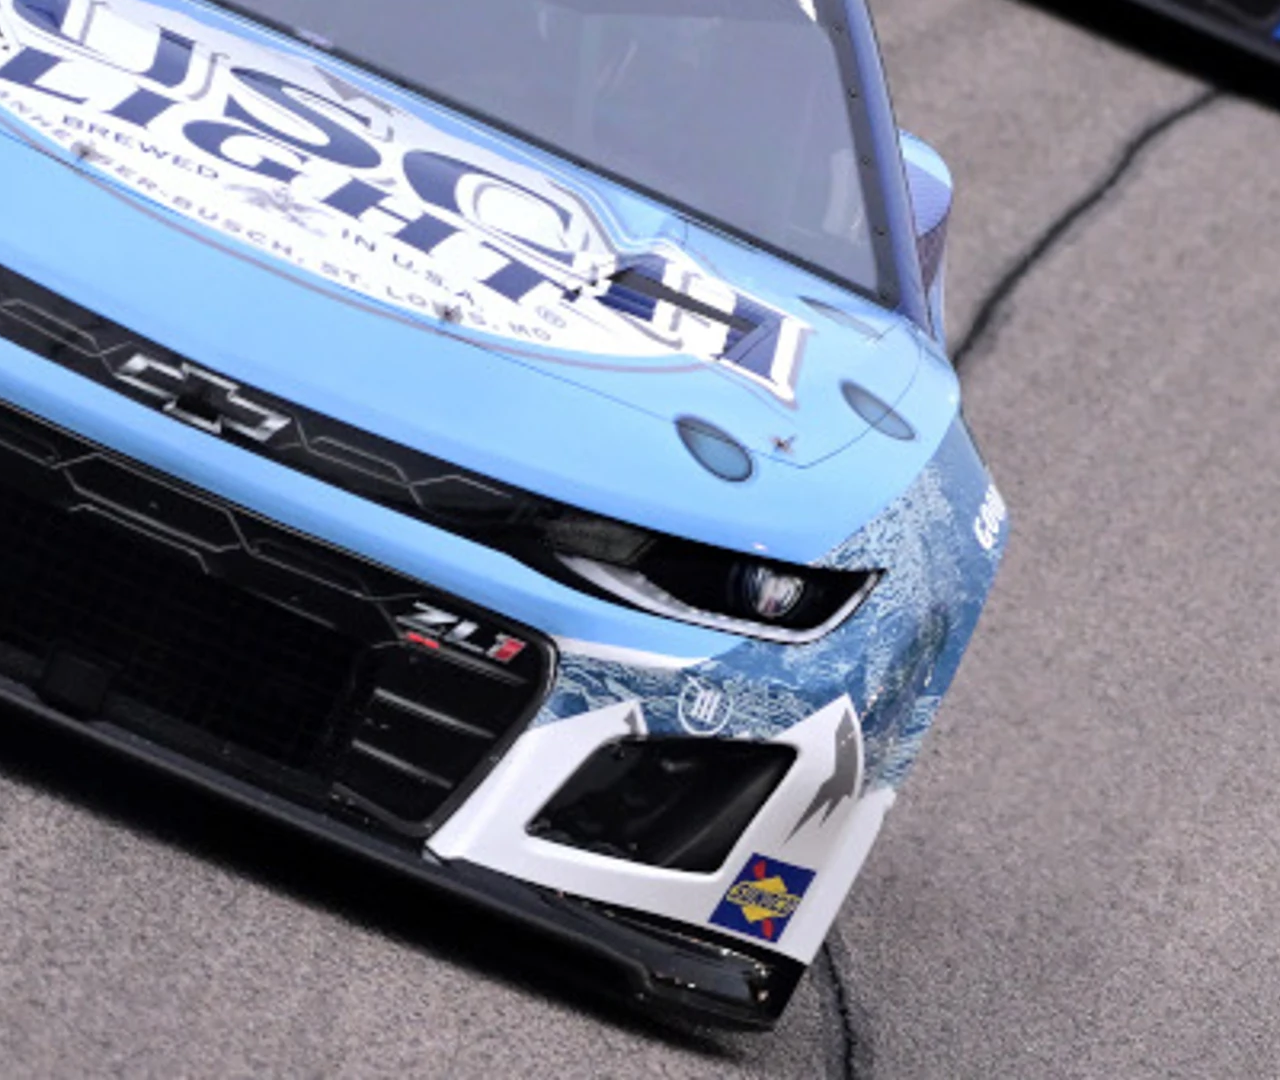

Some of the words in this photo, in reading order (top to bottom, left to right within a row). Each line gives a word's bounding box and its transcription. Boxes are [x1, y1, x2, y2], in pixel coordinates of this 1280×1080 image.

[61, 113, 219, 180] BREWED
[342, 228, 375, 253] IN
[395, 600, 527, 664] ZL1
